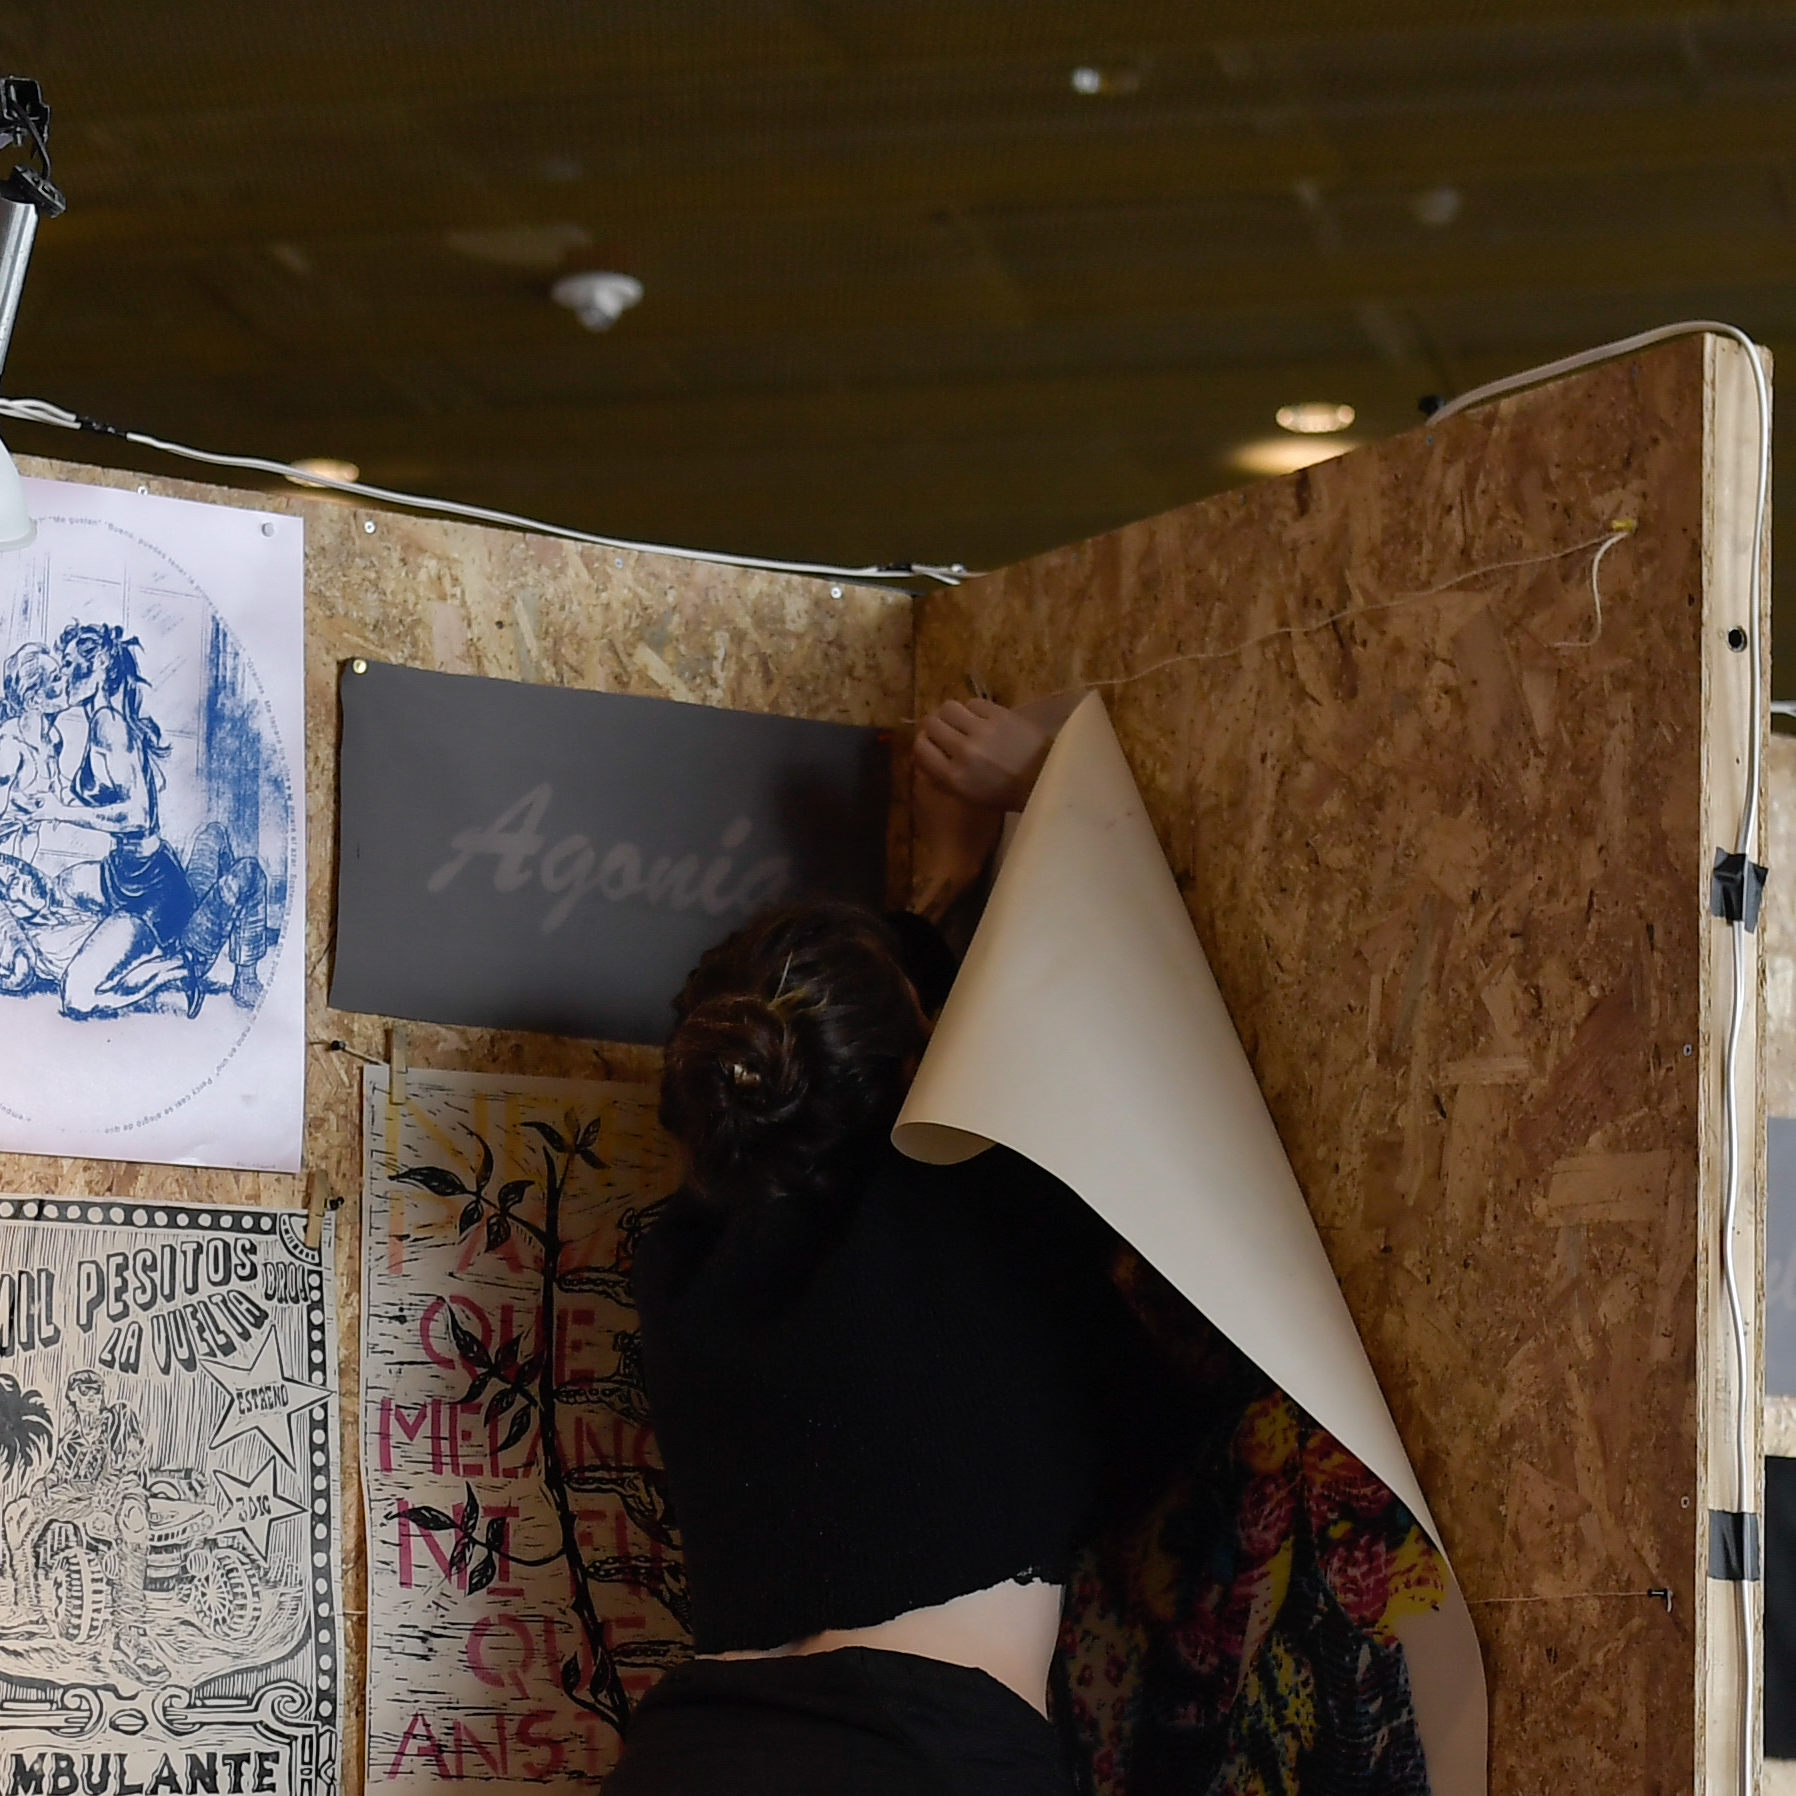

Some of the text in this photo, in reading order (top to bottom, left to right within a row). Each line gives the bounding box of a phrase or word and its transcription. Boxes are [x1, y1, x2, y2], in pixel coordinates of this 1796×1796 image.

[76, 1237, 258, 1333] PESITOS
[99, 1287, 269, 1376] LA VUELTA
[236, 1383, 290, 1415] ESTRENO
